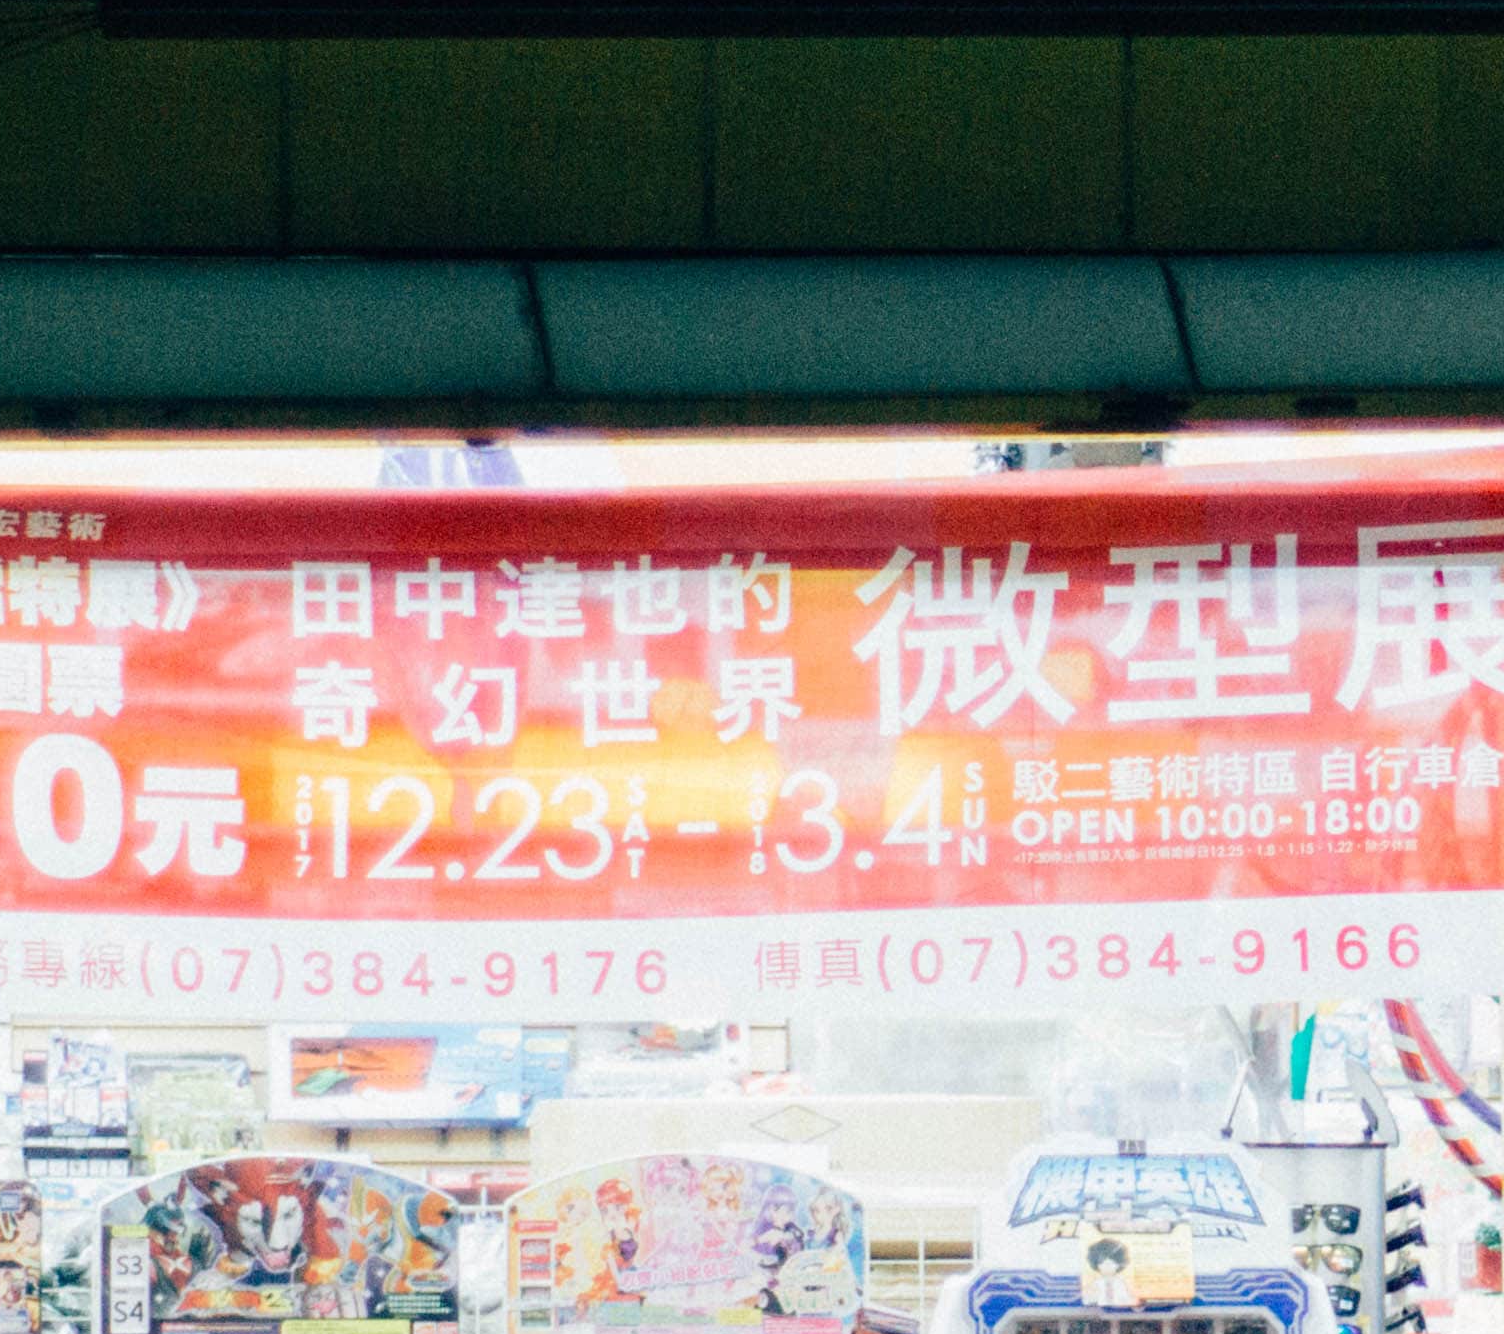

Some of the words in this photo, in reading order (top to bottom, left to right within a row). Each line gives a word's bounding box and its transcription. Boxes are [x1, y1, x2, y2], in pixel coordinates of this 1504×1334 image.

[292, 551, 792, 641] 田中達也的
[295, 657, 802, 751] 奇幻世界
[1012, 750, 1297, 803] 駁二藝術特區
[320, 773, 615, 883] 12.23
[623, 778, 649, 879] SAT
[776, 763, 952, 873] 3.4
[960, 760, 987, 867] SUN
[1013, 808, 1133, 844] OPEN
[1155, 797, 1421, 841] 10:00-18:00
[116, 1255, 143, 1276] S3
[114, 1300, 145, 1324] S4
